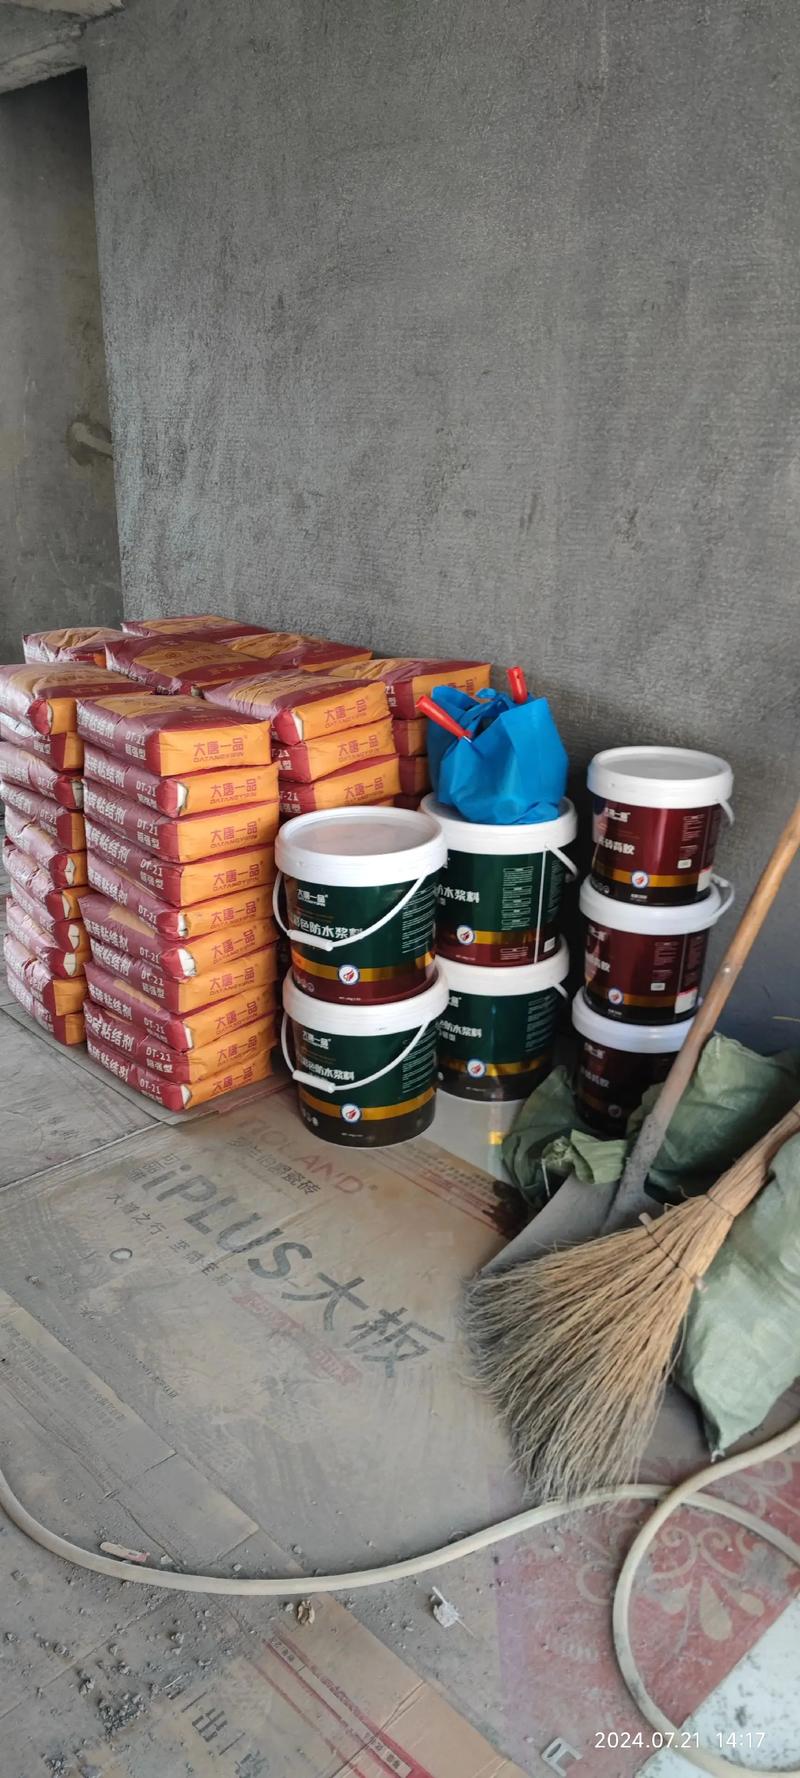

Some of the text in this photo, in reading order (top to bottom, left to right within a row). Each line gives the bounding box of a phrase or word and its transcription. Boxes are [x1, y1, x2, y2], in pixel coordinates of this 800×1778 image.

[125, 731, 145, 746] DT-21
[193, 737, 244, 757] 大唐一品
[136, 780, 156, 796] DT-21
[210, 778, 257, 798] 大唐一品
[137, 818, 158, 835] DT-21
[210, 821, 258, 842] 大唐一品
[140, 859, 163, 877] DT-21
[138, 904, 157, 925] DT-21
[140, 947, 161, 963] DT-21
[141, 966, 164, 986] DT-21
[143, 1017, 165, 1034] DT-21
[146, 1047, 171, 1062] DT-21
[140, 1079, 161, 1094] DT-21
